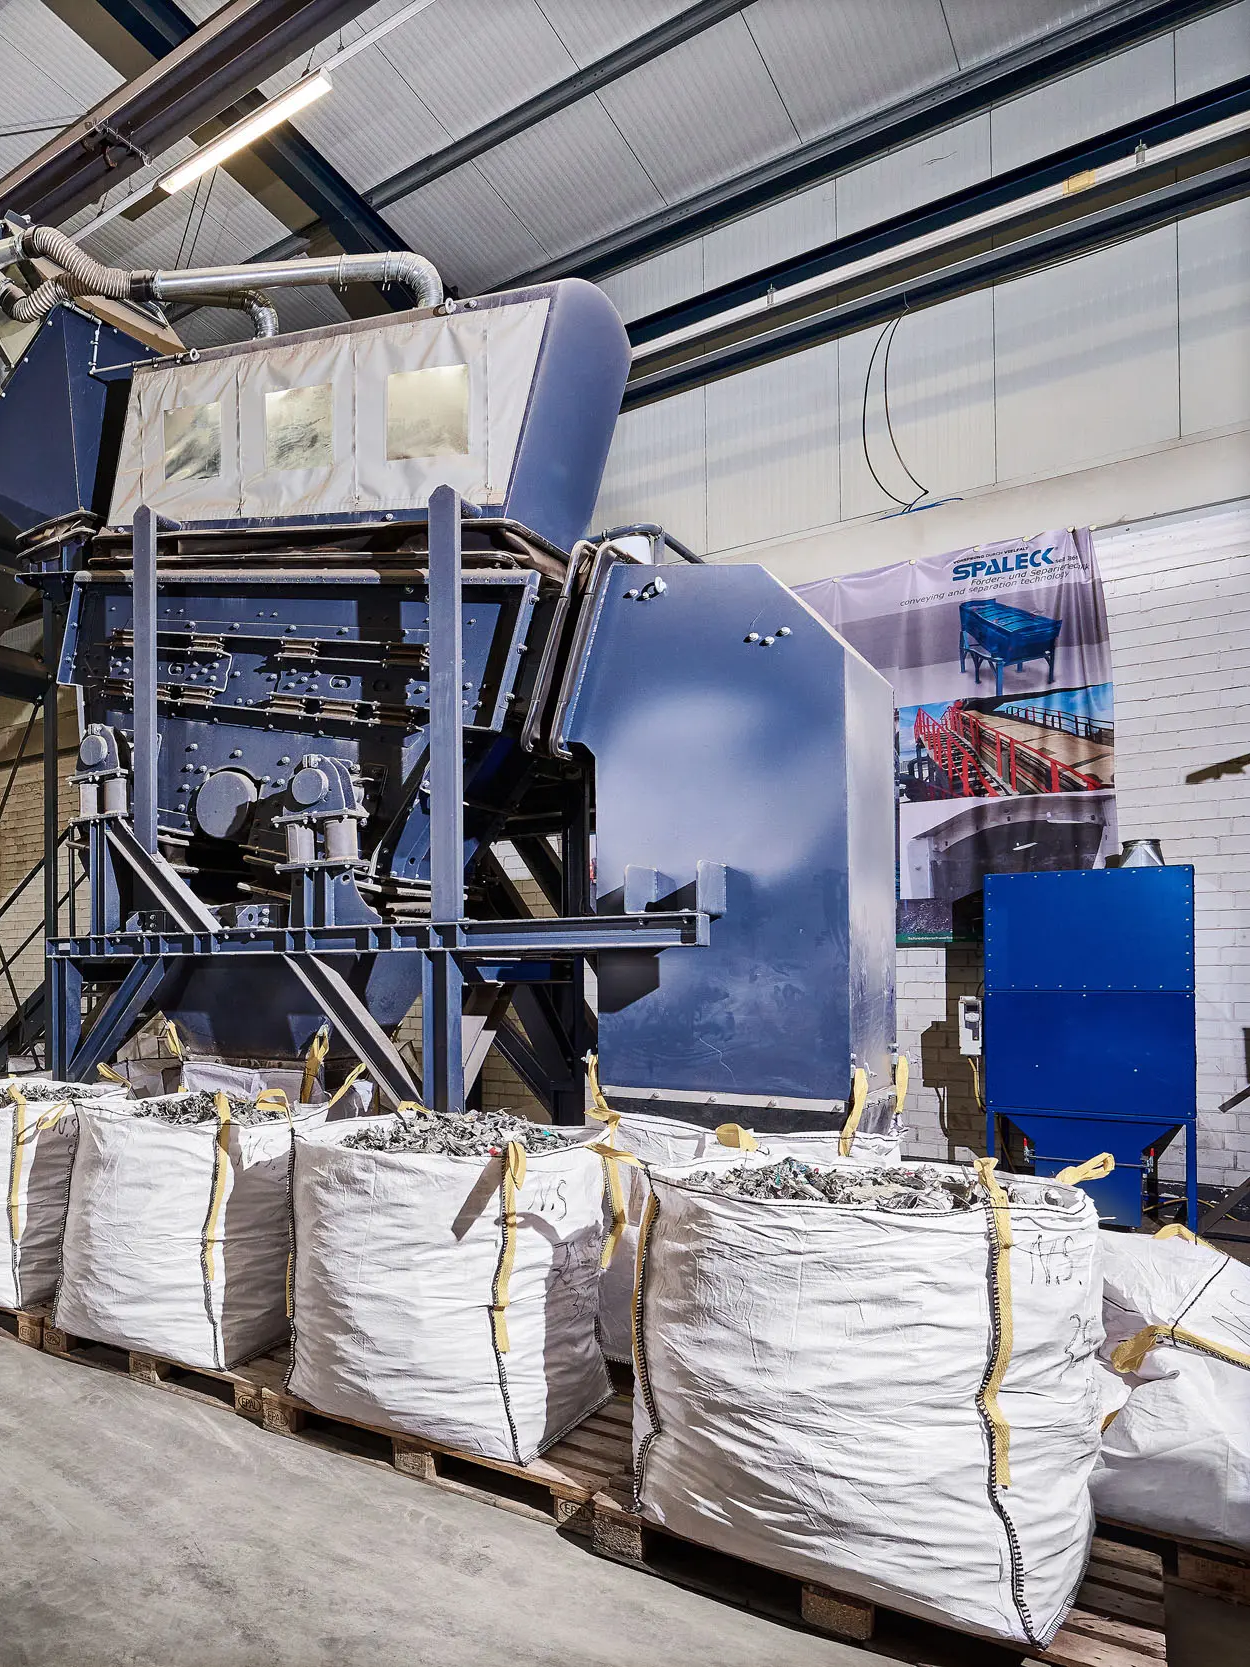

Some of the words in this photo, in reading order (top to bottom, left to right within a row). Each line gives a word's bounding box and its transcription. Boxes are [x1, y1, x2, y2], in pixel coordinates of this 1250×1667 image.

[952, 546, 1056, 581] SPALECK
[1008, 571, 1028, 580] und
[899, 591, 945, 607] conveying
[947, 587, 966, 597] and
[968, 579, 1018, 593] separation
[1020, 570, 1070, 585] technology
